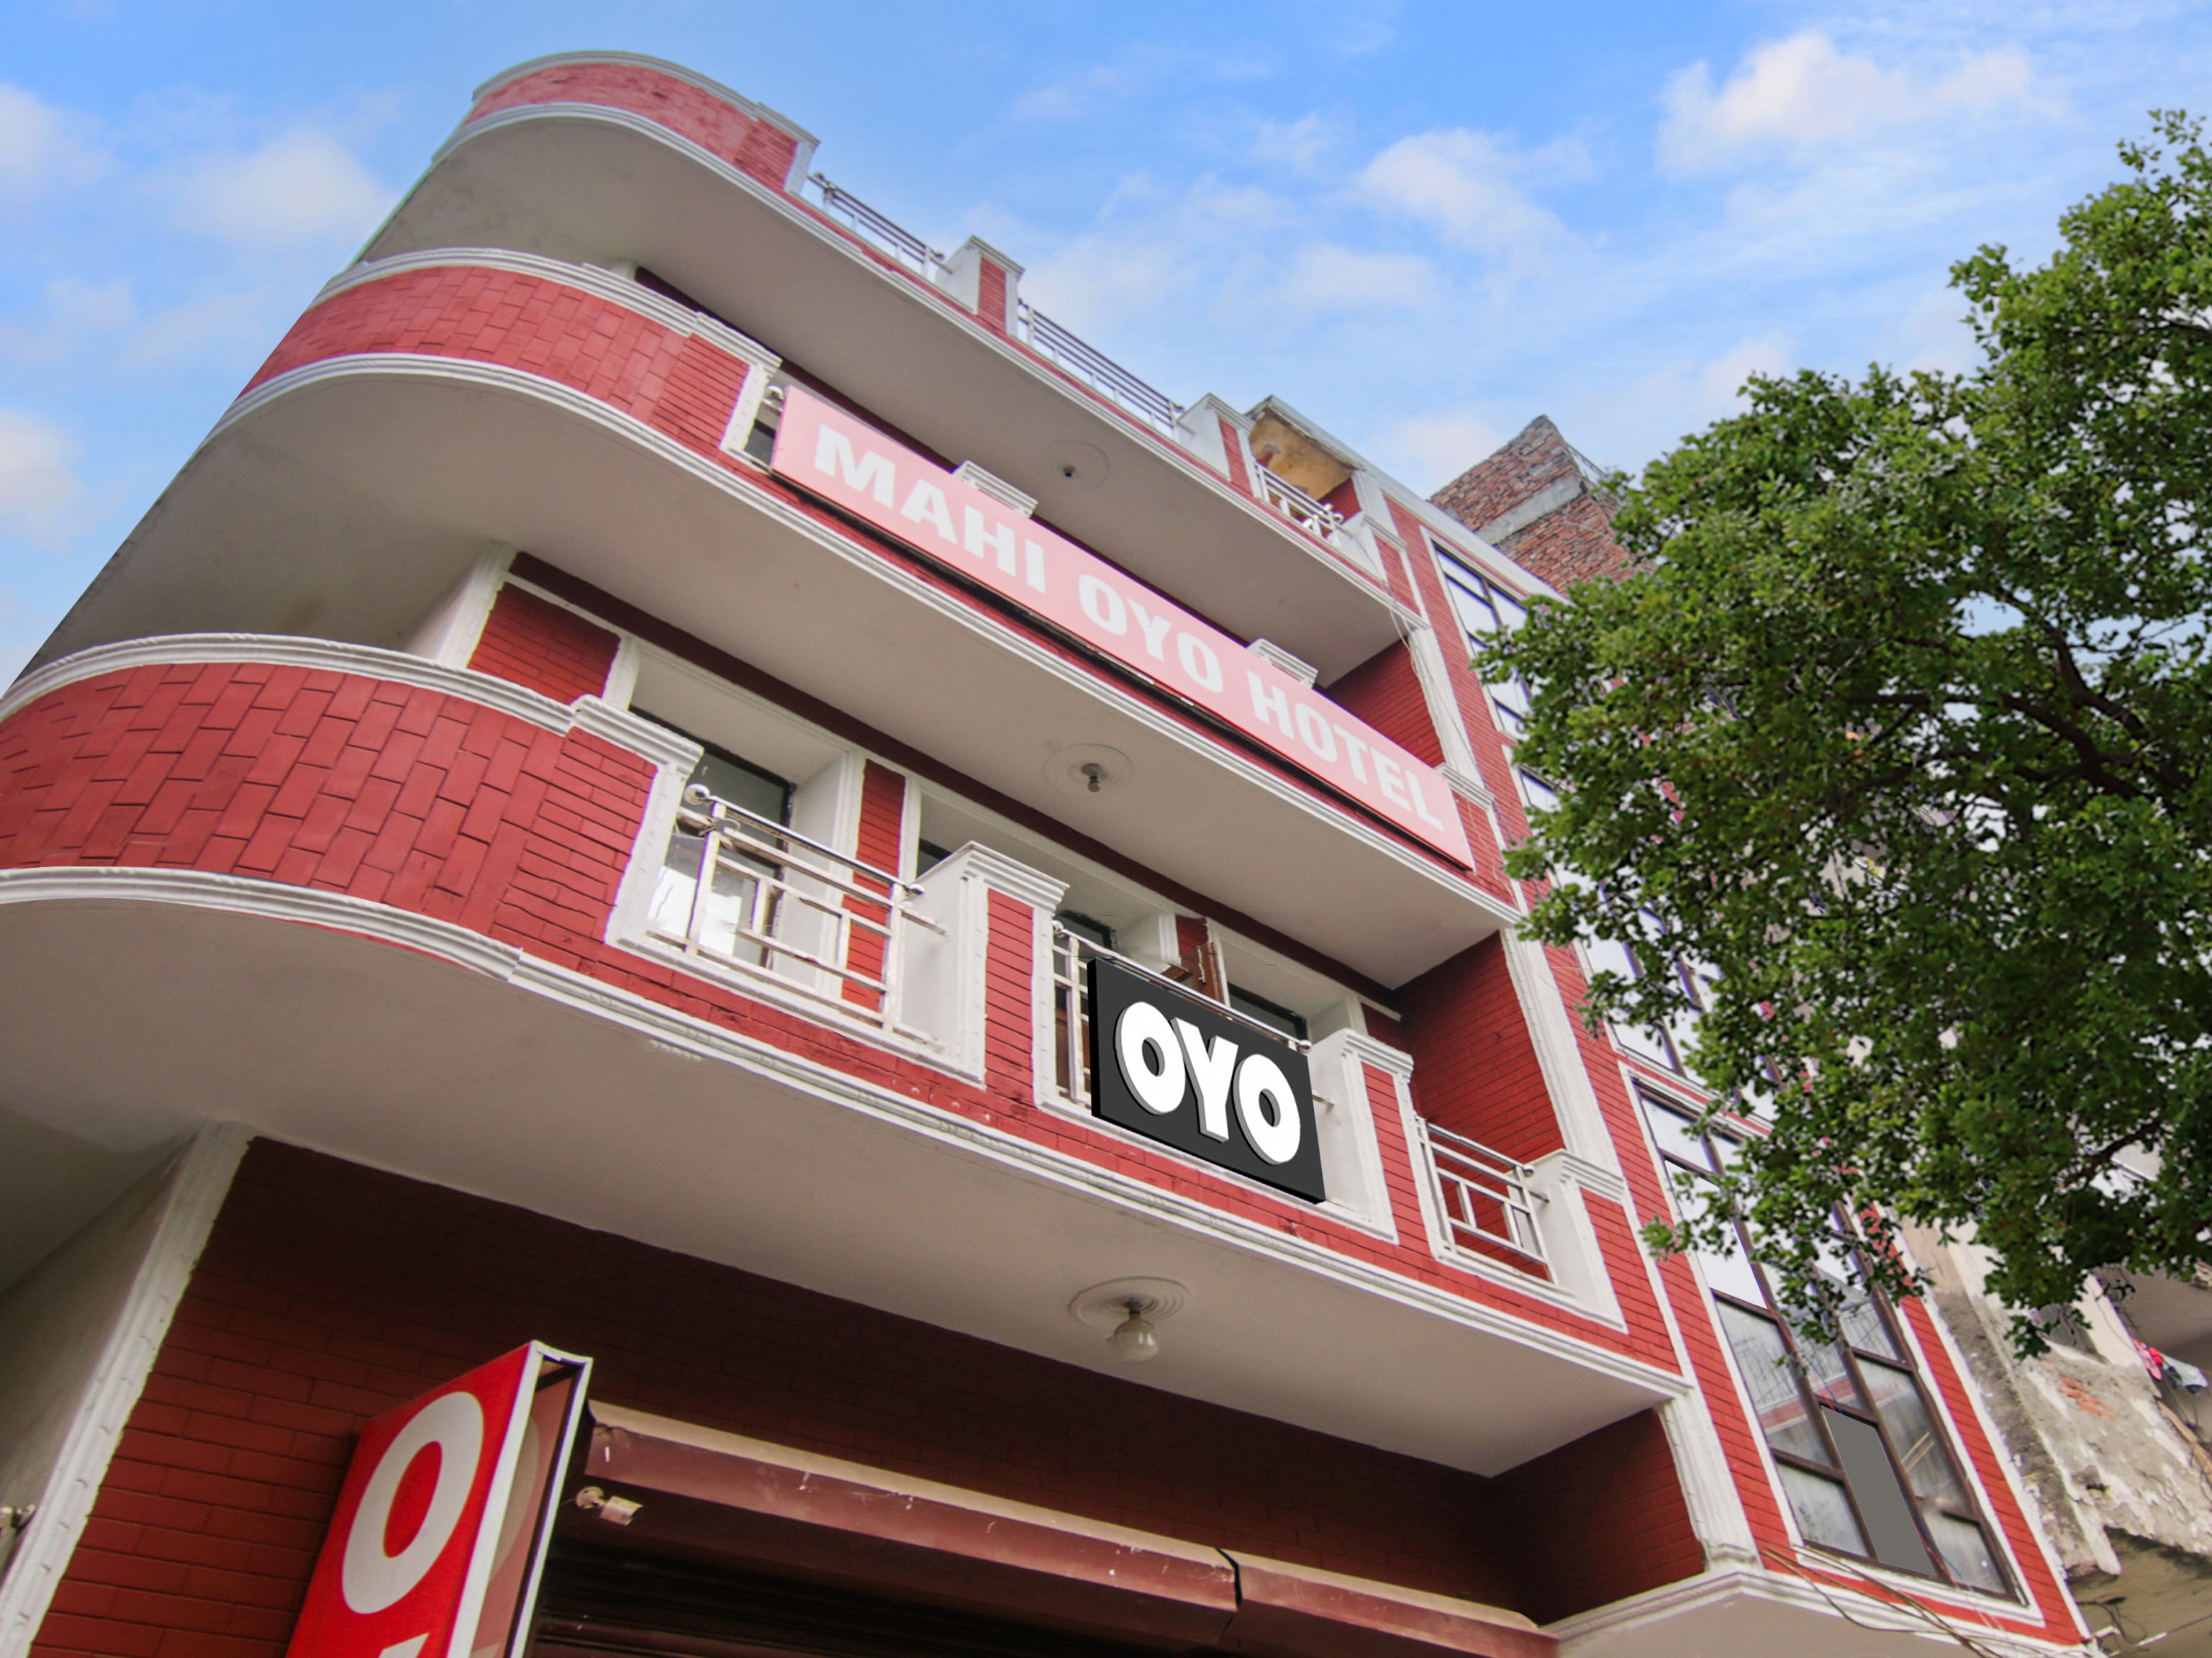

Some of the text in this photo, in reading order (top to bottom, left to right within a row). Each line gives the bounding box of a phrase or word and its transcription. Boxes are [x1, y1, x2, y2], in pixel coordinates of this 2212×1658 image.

[815, 425, 1444, 831] MAHI OYO HOTEL
[1115, 1002, 1301, 1164] OYO
[342, 1392, 484, 1658] O
